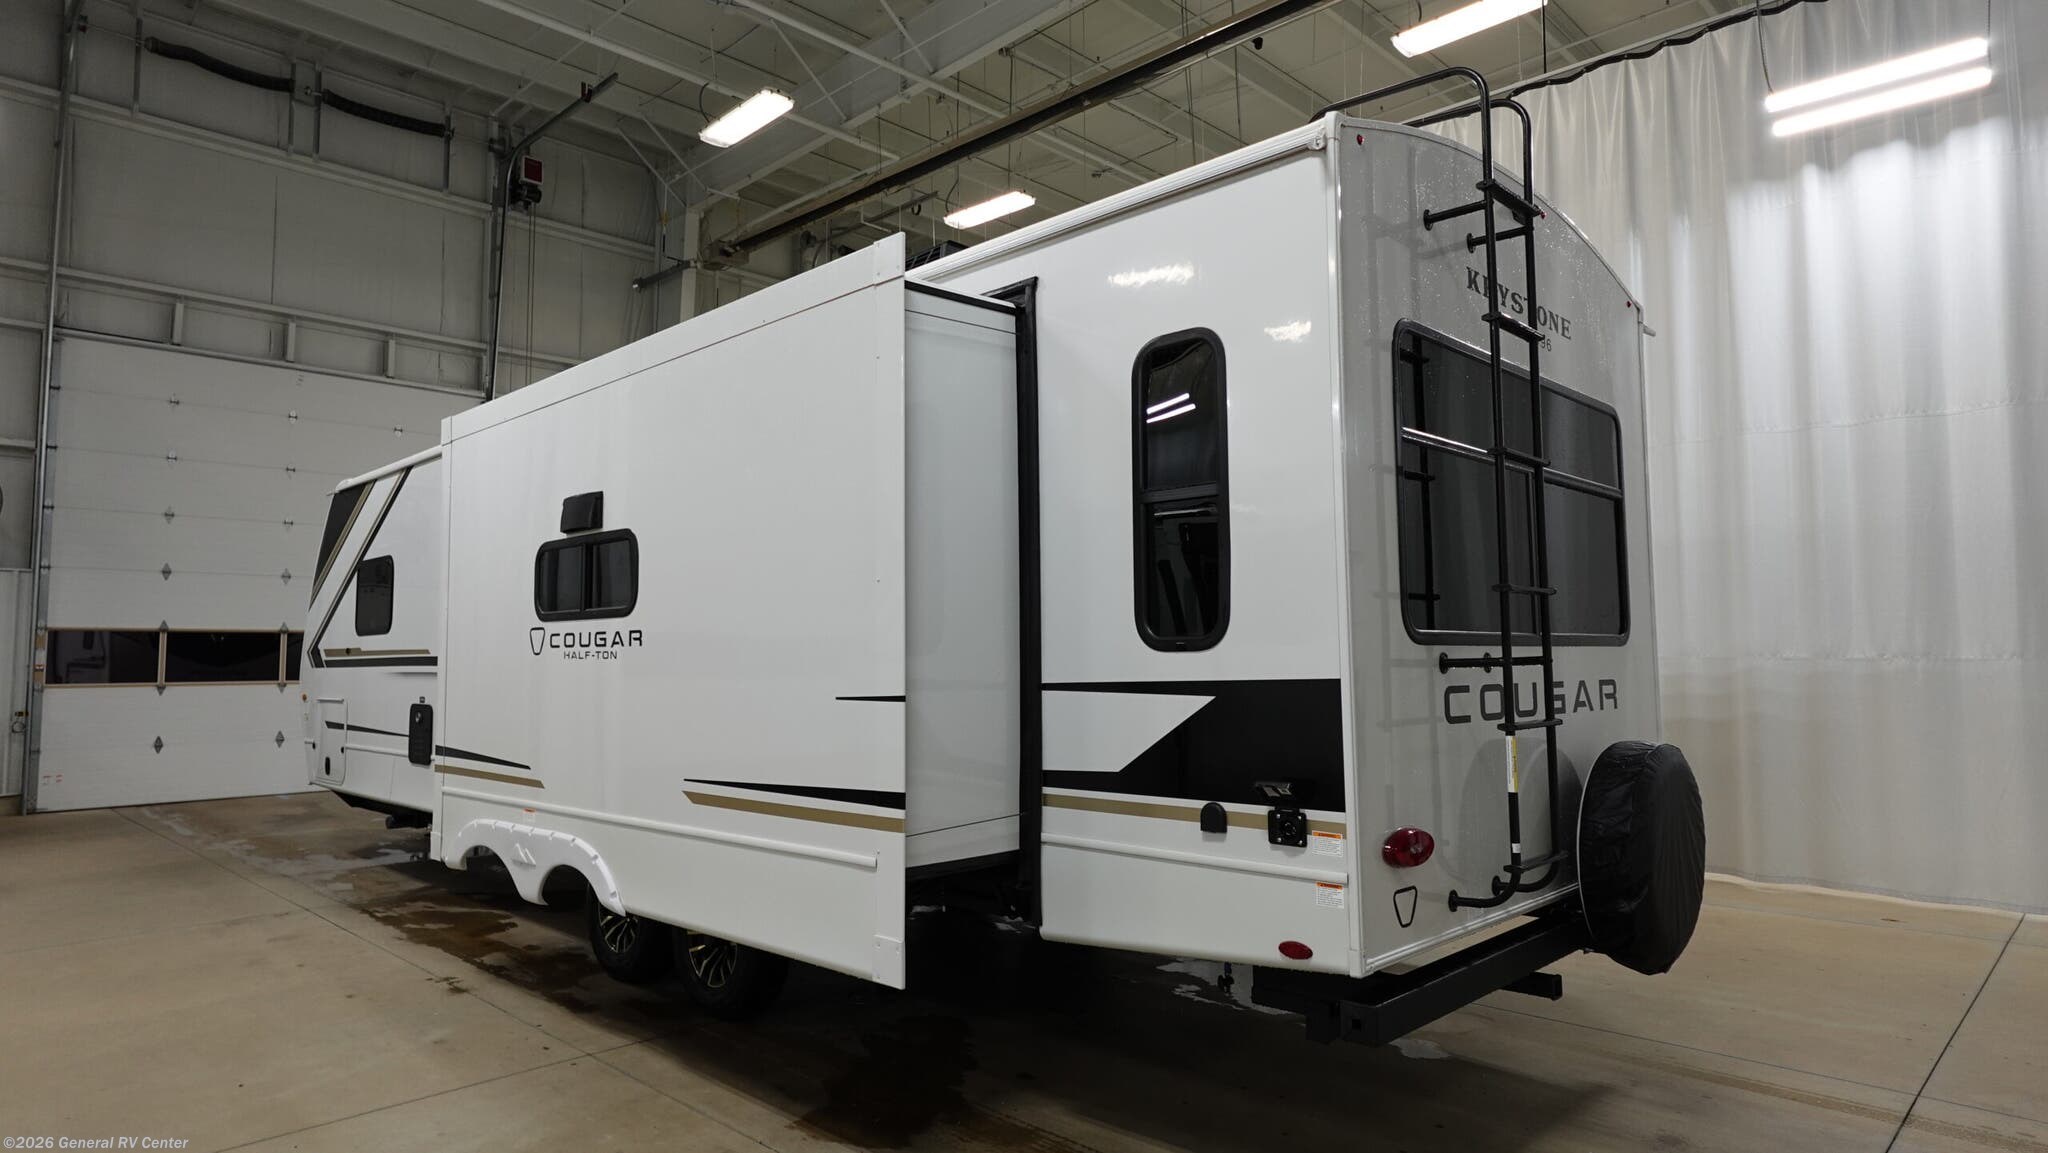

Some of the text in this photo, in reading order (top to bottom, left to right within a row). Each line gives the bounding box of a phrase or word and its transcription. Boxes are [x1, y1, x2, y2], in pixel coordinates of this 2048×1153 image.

[1466, 266, 1571, 340] KYSONE
[550, 630, 642, 649] COUGAR
[564, 650, 617, 660] HALF-TON
